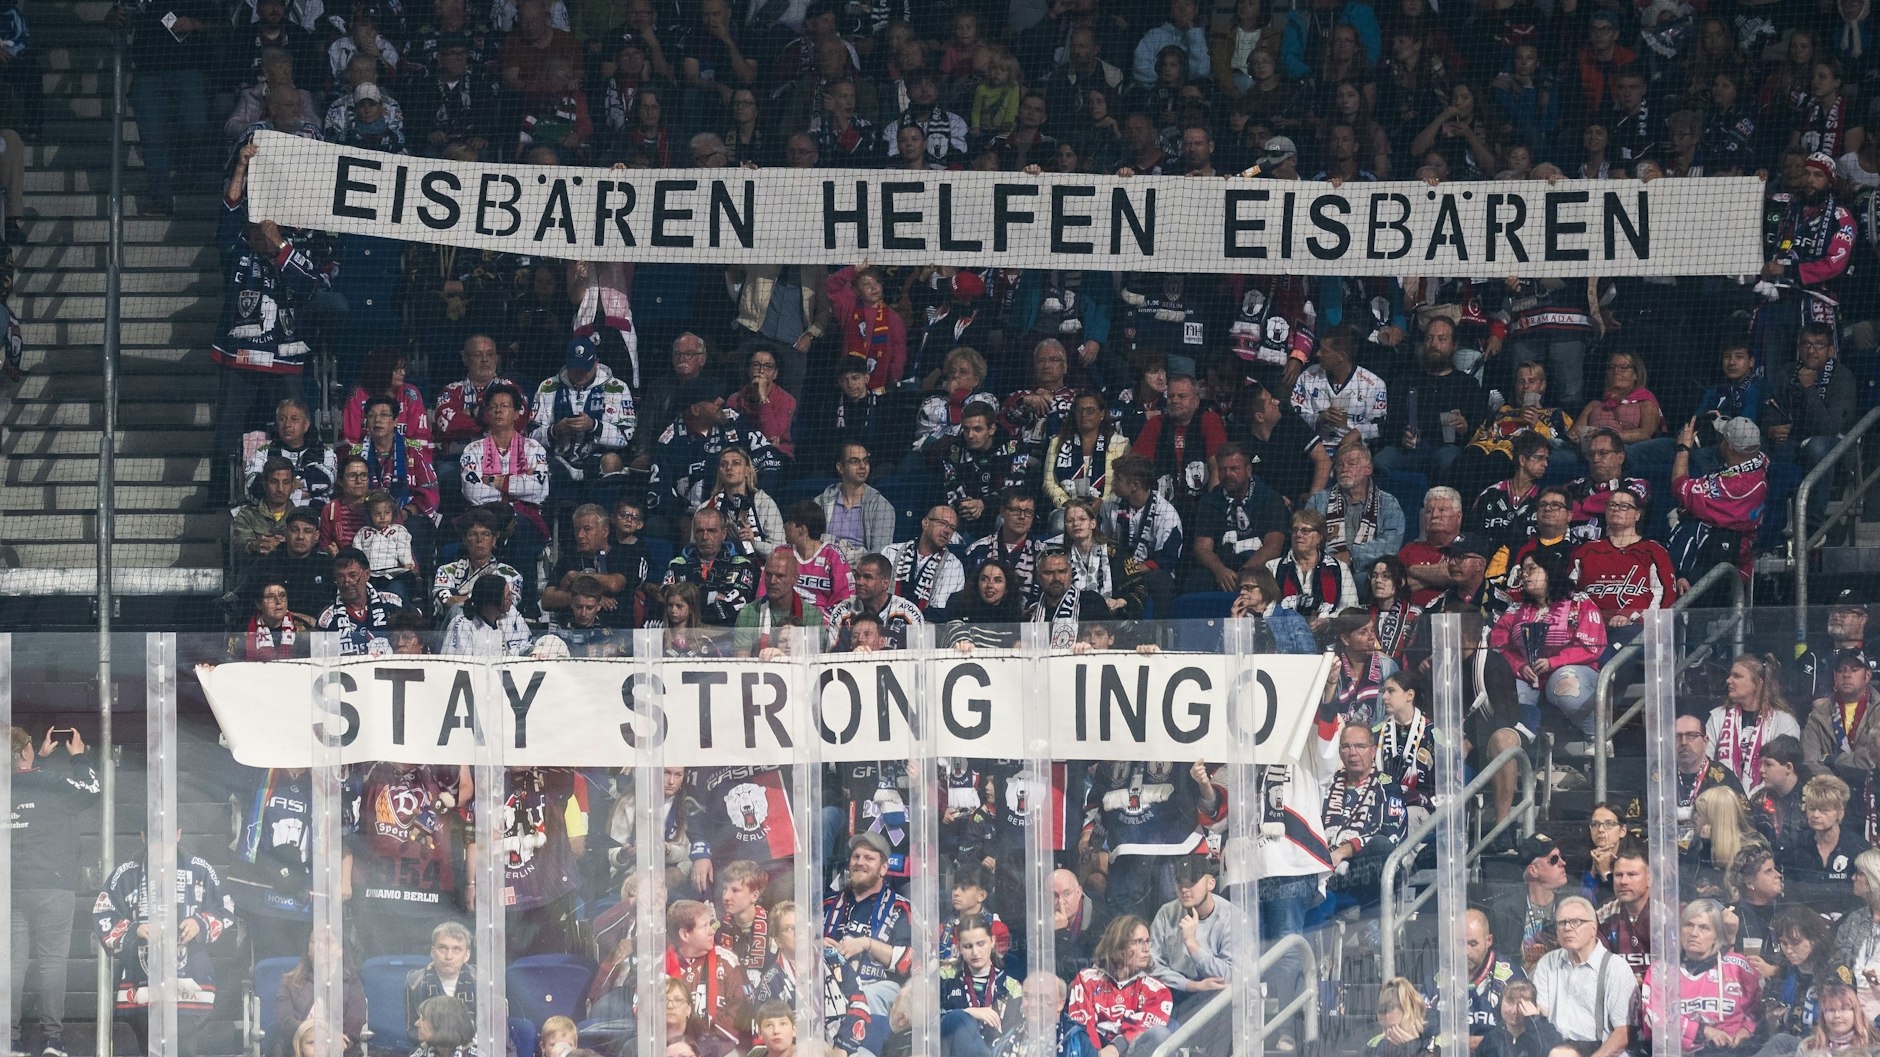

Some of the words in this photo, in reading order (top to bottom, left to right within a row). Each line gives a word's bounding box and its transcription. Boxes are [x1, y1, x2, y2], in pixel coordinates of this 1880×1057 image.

[333, 155, 754, 248] EISBÄREN
[823, 180, 1156, 256] HELFEN
[1224, 190, 1650, 262] EISBÄREN
[1530, 314, 1574, 323] RAMADA
[747, 430, 771, 451] 22
[1585, 565, 1650, 609] capitals
[312, 667, 546, 749] STAY
[620, 662, 992, 750] STRONG
[1075, 664, 1278, 747] INGO
[1007, 814, 1042, 827] BERLIN
[735, 825, 772, 842] BERLIN
[505, 864, 535, 879] ERLIN
[403, 890, 440, 904] BERLIN
